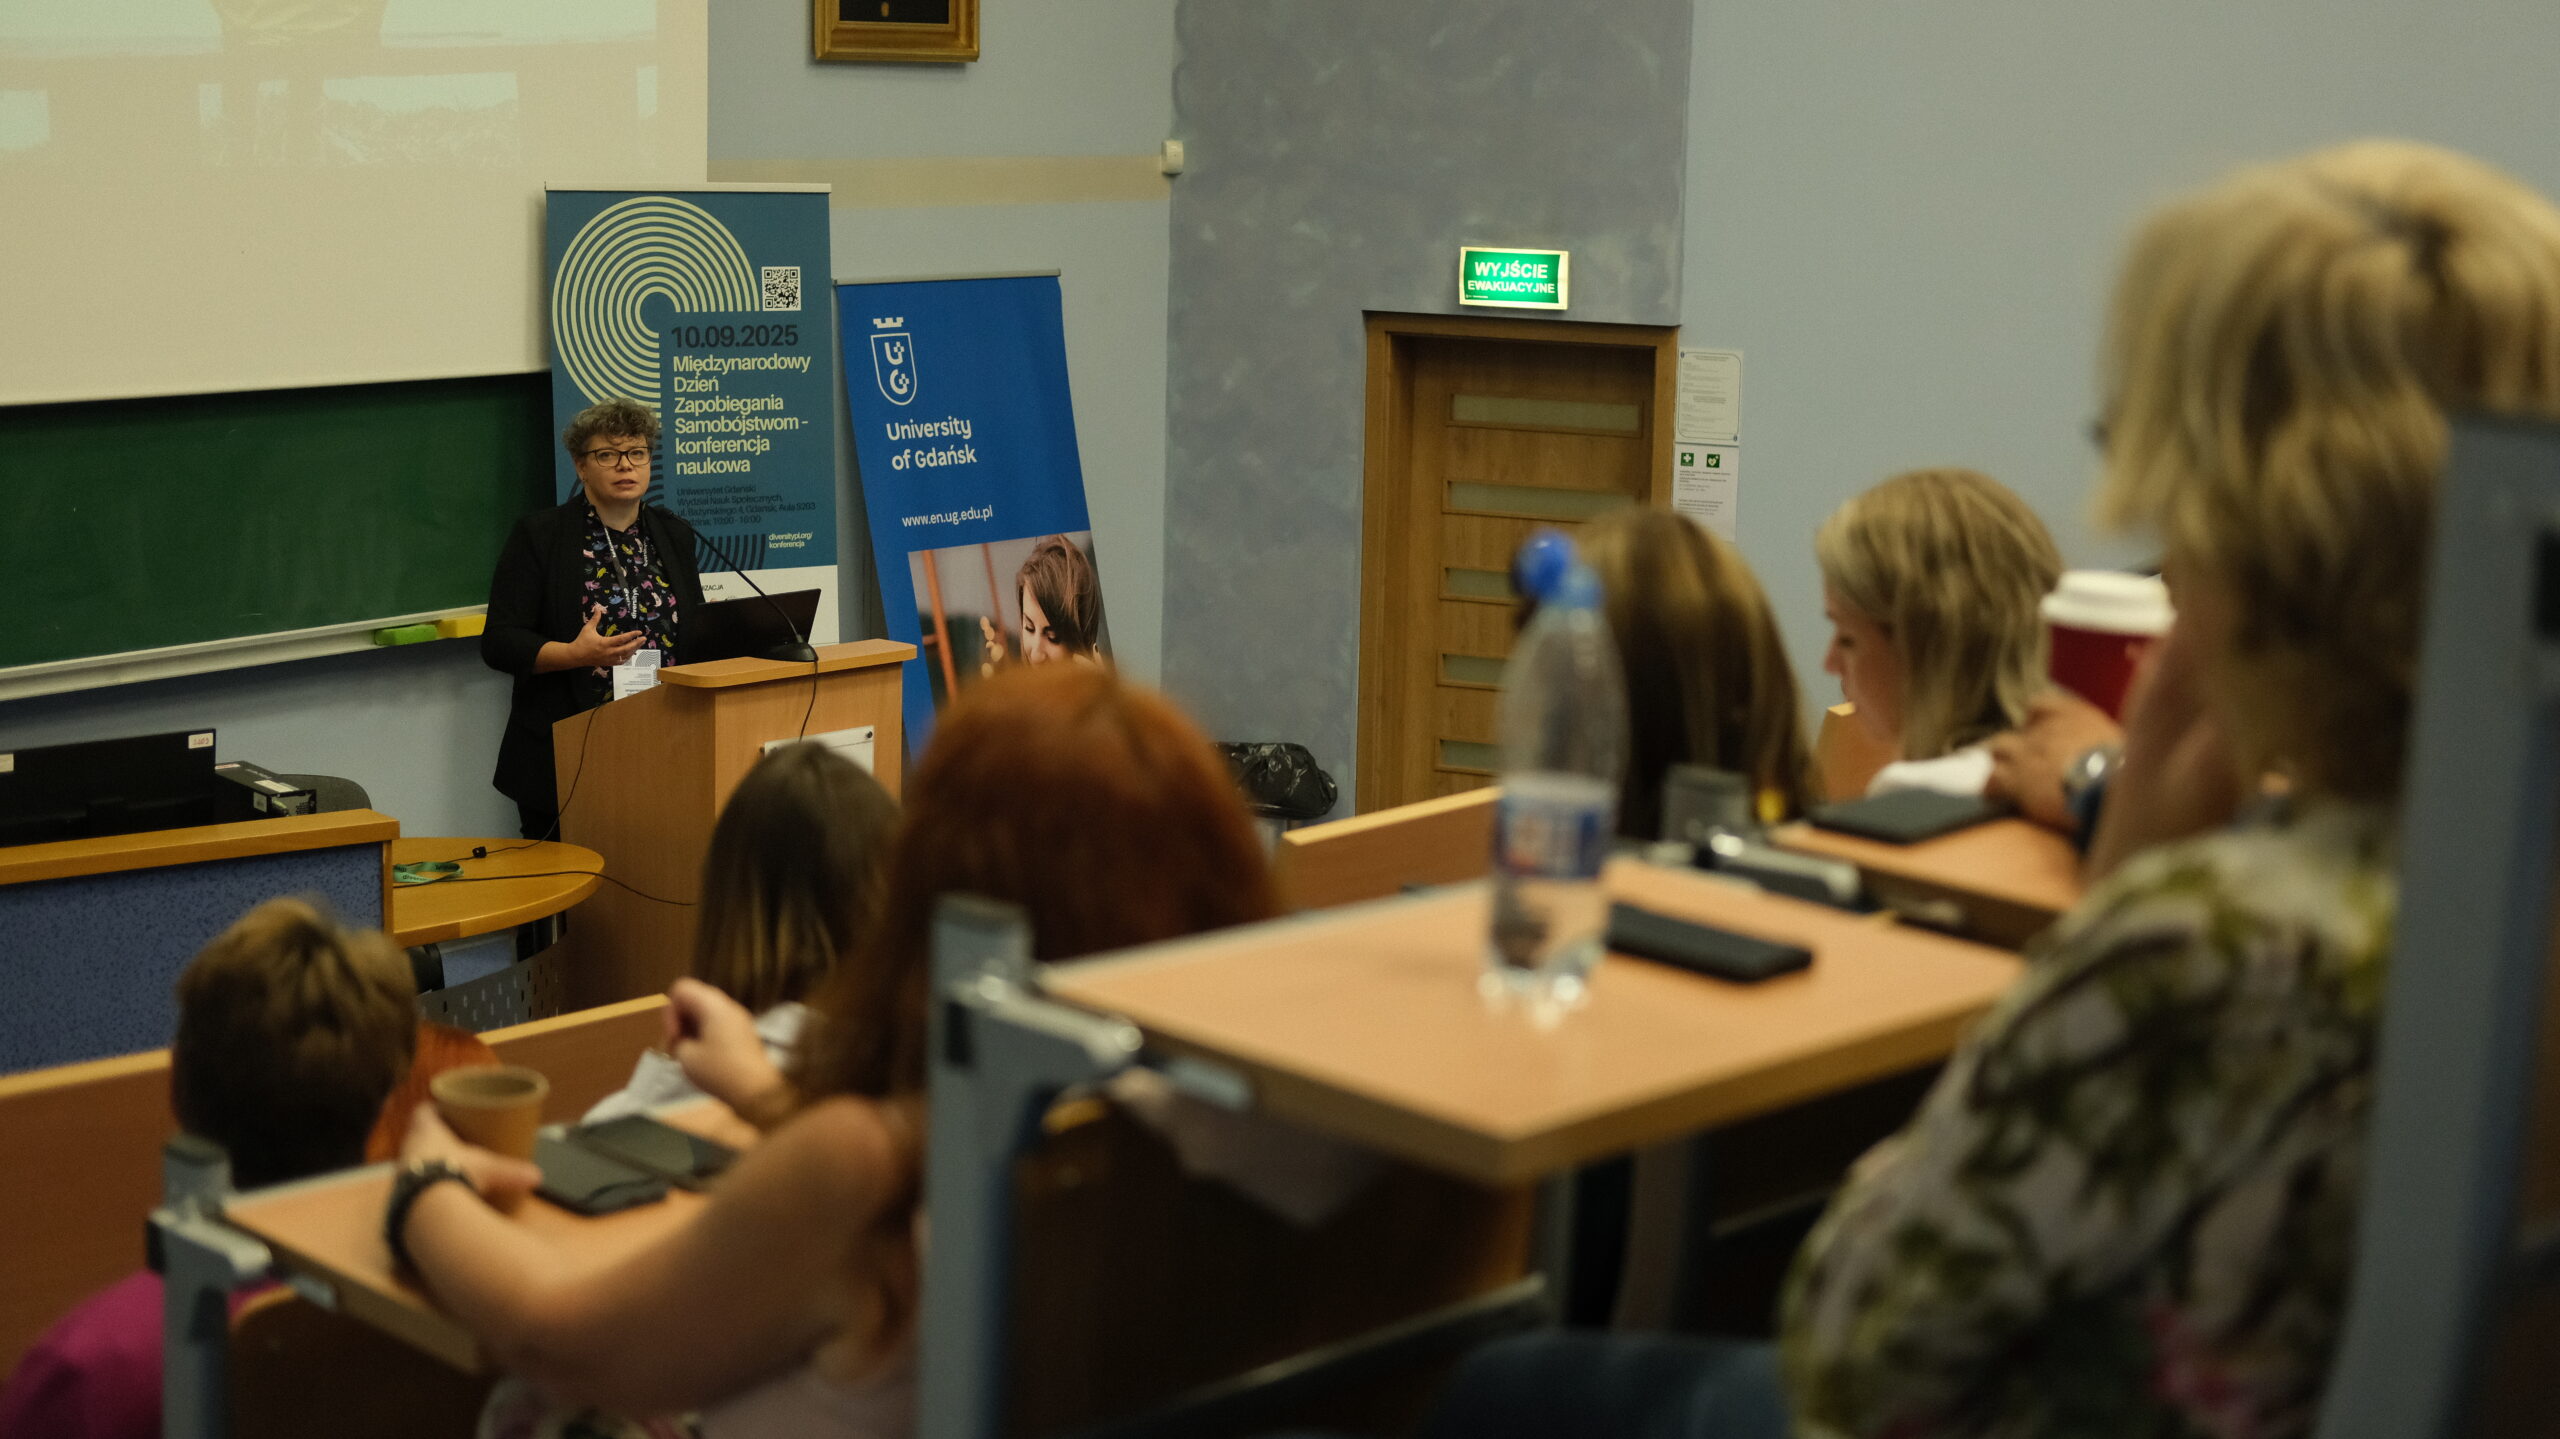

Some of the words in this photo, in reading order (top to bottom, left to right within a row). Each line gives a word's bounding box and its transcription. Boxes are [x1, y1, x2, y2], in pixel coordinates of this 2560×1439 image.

[1475, 260, 1548, 278] WYJŚCIE
[1467, 280, 1555, 293] EWAKUACYJNE
[671, 324, 799, 348] 10.09.2025
[673, 352, 811, 376] Międzynarodowy
[674, 376, 719, 392] Dzień
[674, 393, 784, 416] Zapobiegania
[675, 415, 799, 435] Samobójstwom
[886, 416, 972, 440] University
[675, 435, 770, 455] konferencja
[676, 457, 751, 475] naukowa
[891, 449, 911, 470] of
[915, 444, 977, 469] Gdańsk
[902, 505, 993, 527] www.en.ug.edu.pl
[769, 540, 805, 549] konferencja
